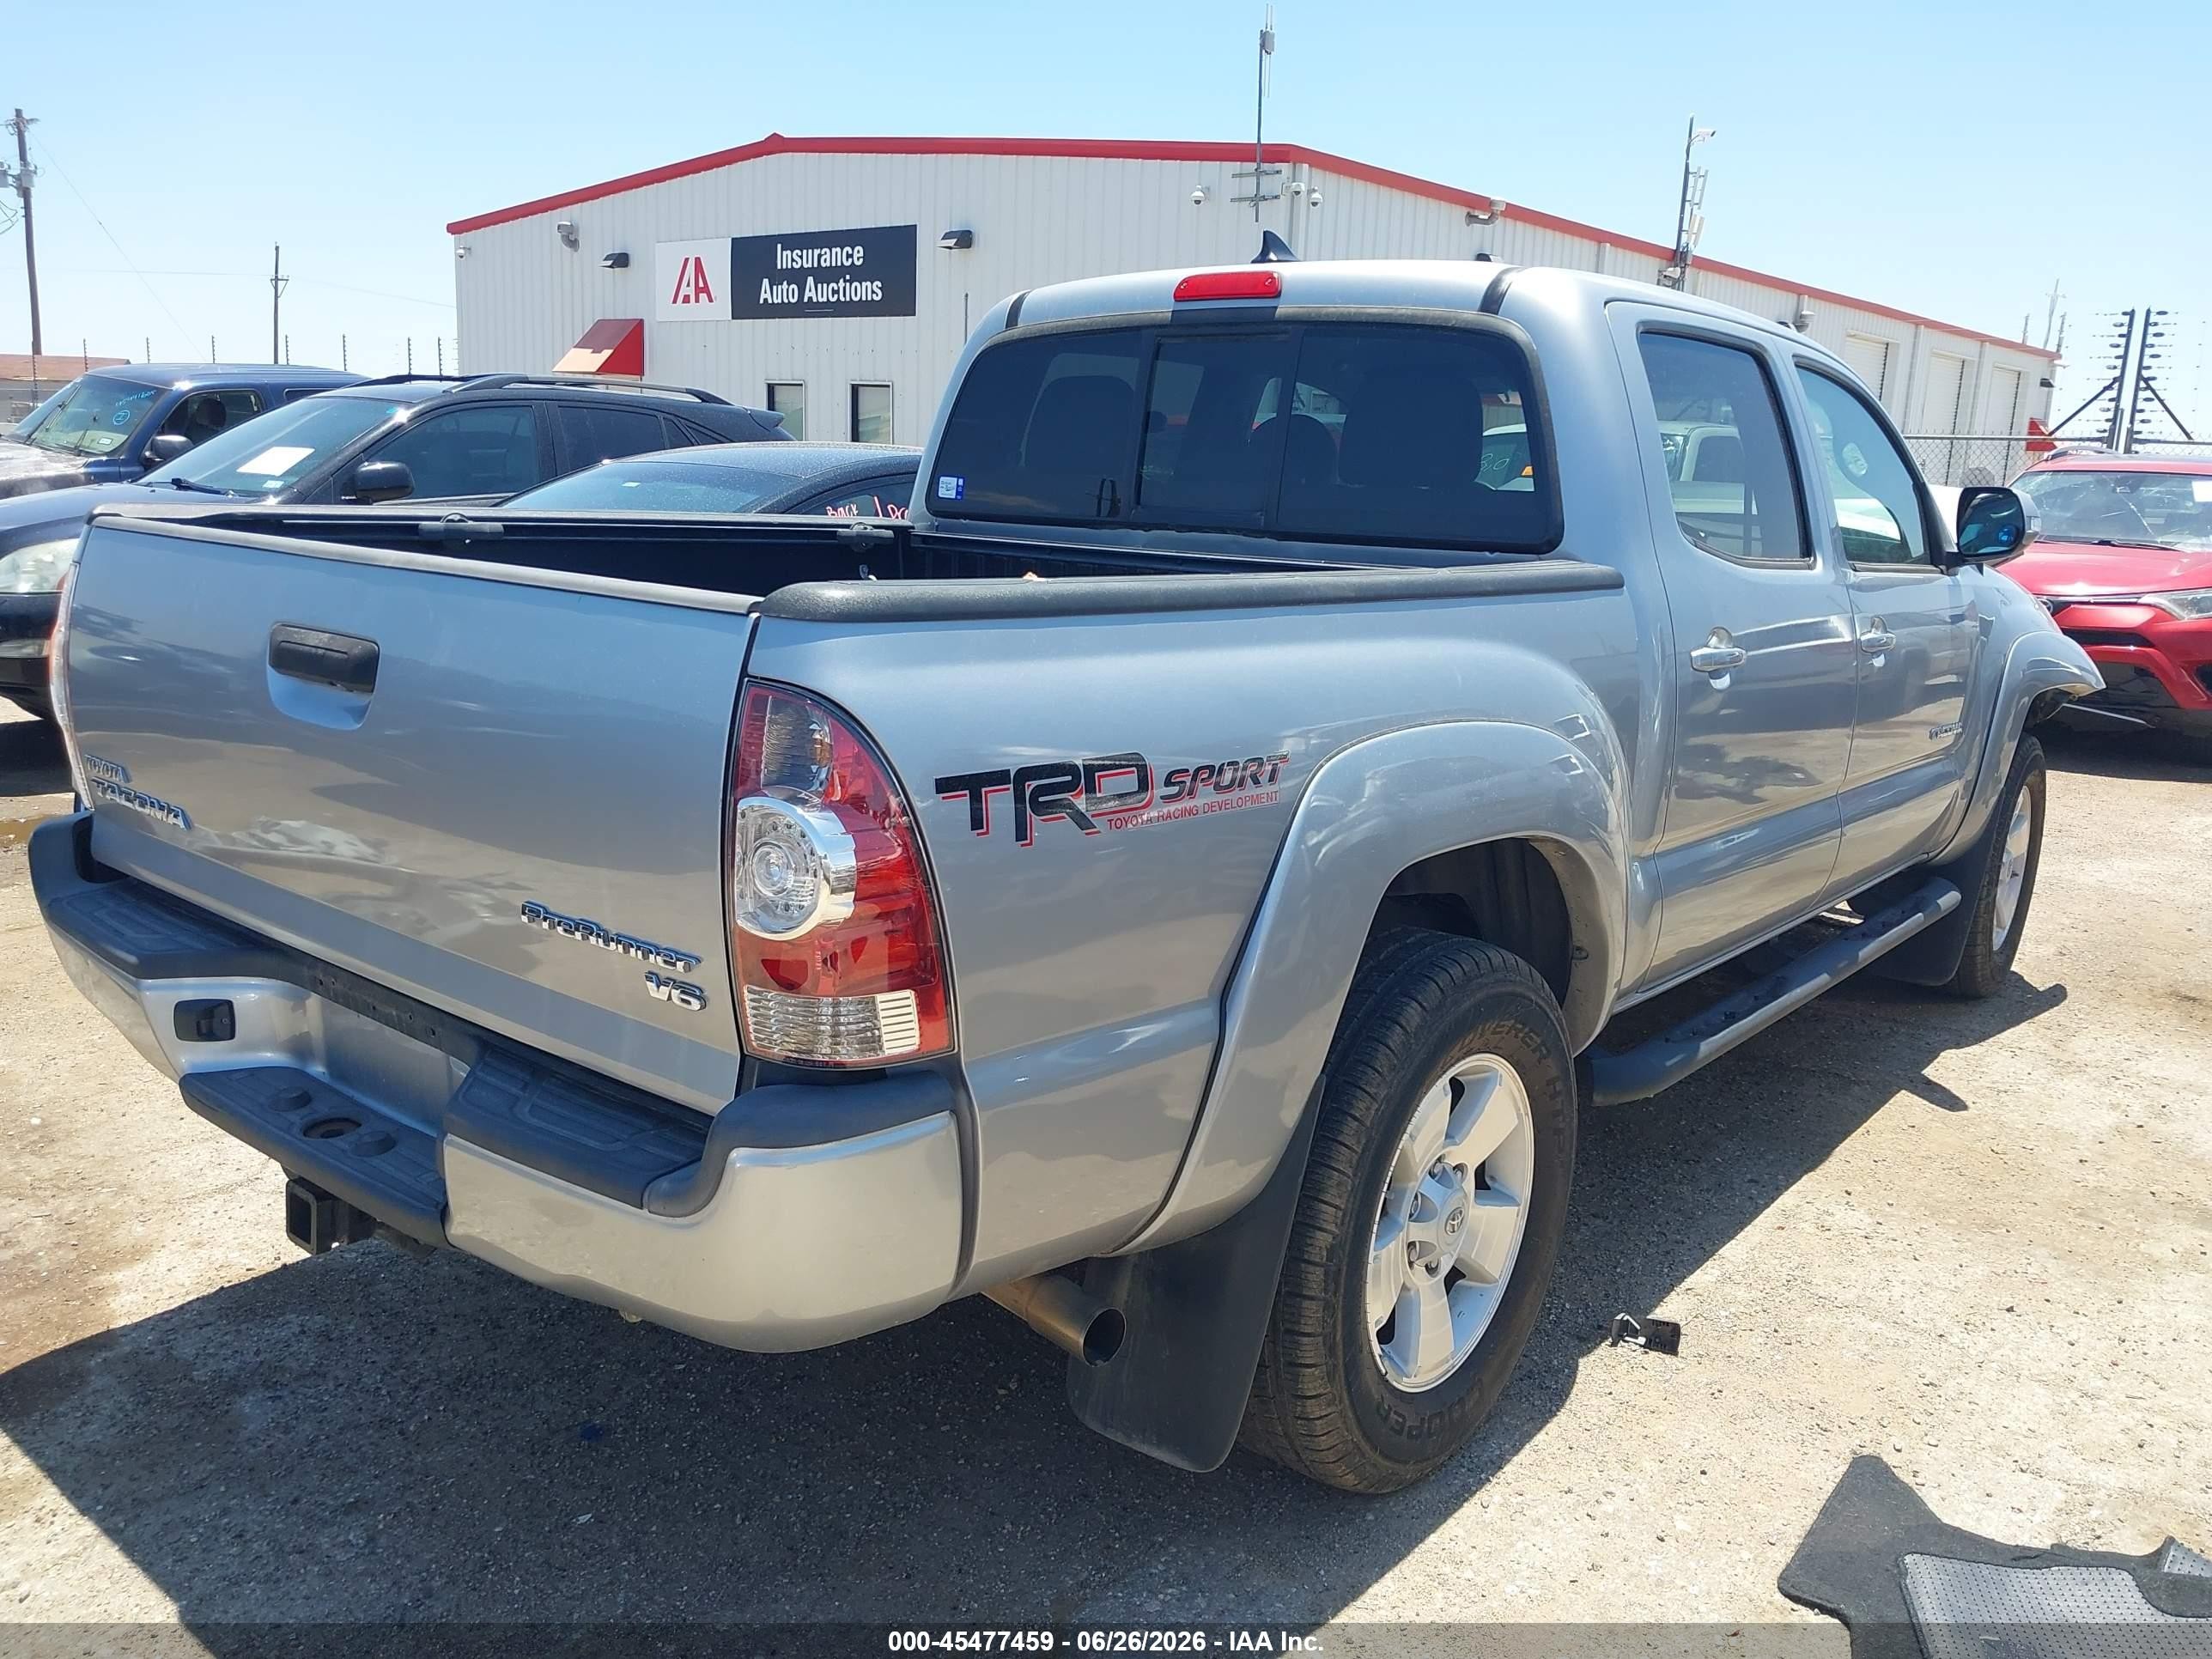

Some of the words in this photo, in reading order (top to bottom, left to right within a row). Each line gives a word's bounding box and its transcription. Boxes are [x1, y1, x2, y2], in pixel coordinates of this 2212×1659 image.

[776, 243, 864, 270] Insurance
[759, 277, 799, 304] Auto
[803, 274, 883, 303] Auctions
[934, 751, 1154, 847] TRD
[1159, 750, 1291, 805] SPORT
[1106, 812, 1153, 831] TOYOTA
[1157, 805, 1199, 823] RACING
[1202, 789, 1279, 814] DEVELOPMENT
[643, 970, 708, 1012] V6
